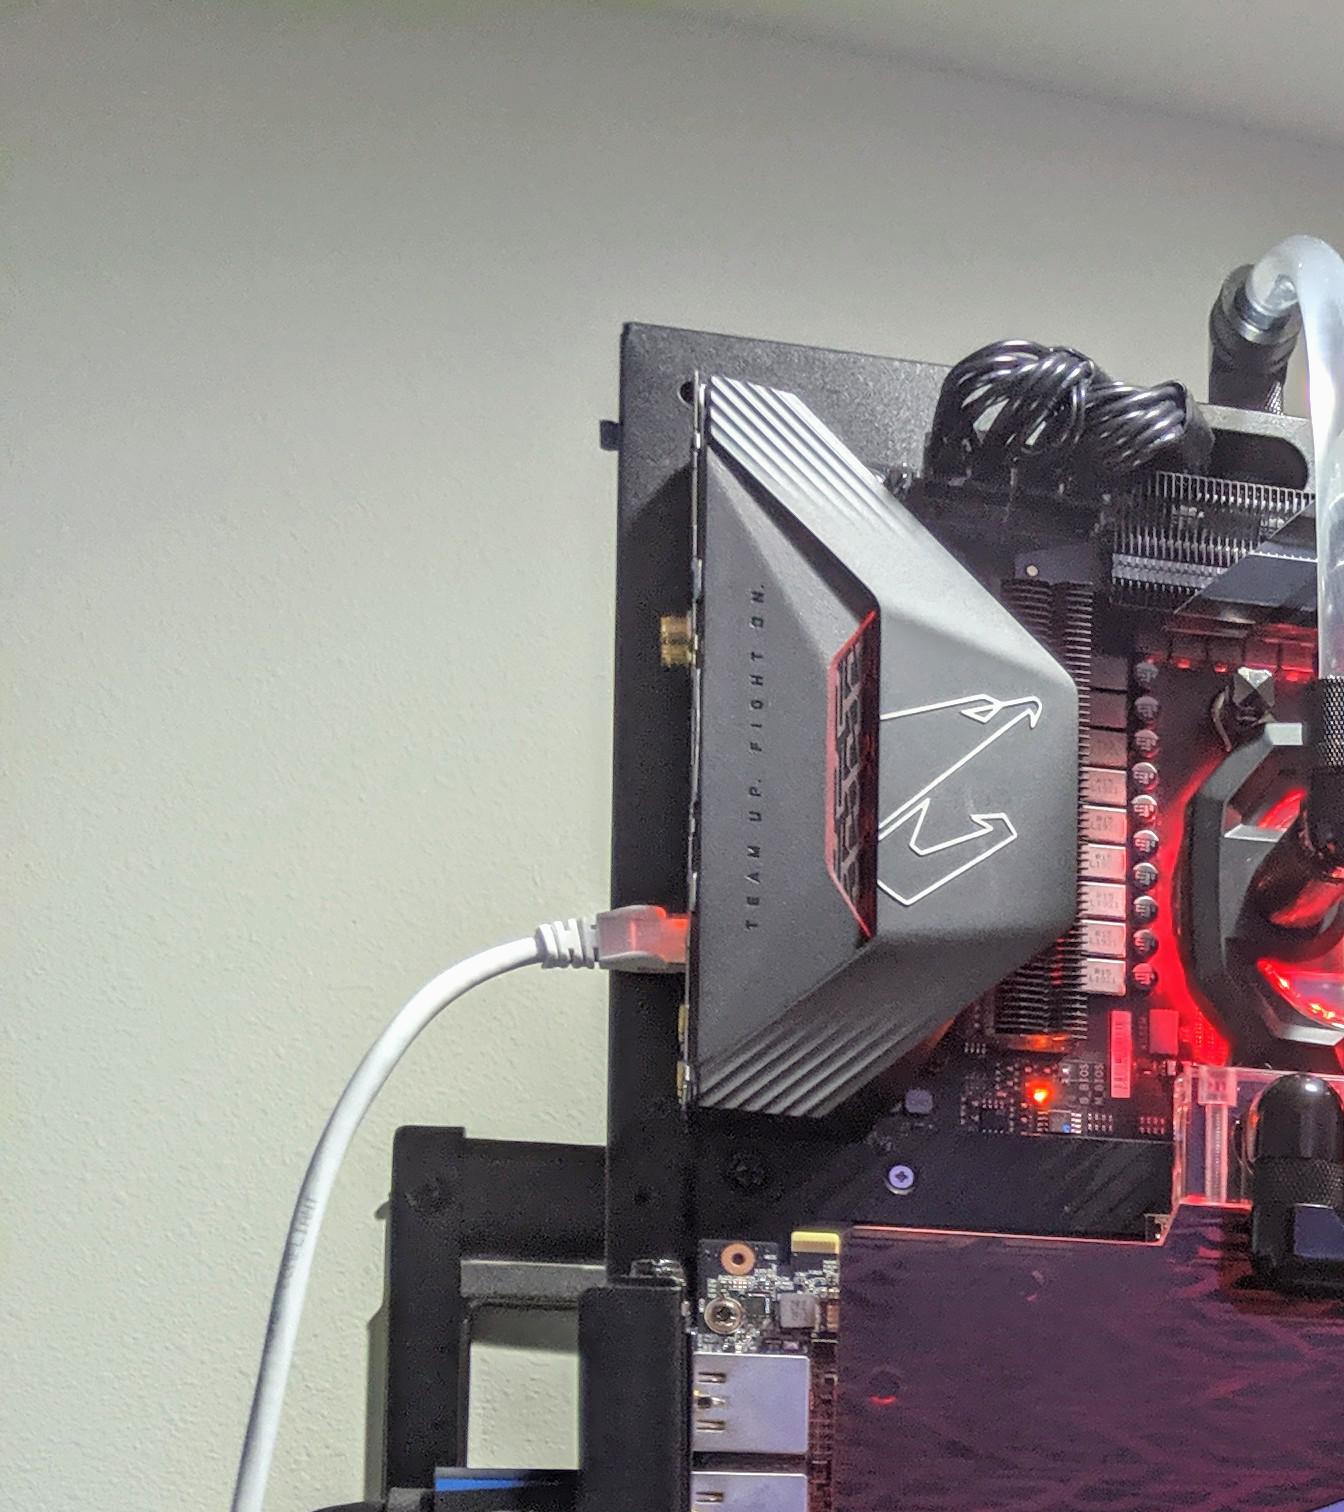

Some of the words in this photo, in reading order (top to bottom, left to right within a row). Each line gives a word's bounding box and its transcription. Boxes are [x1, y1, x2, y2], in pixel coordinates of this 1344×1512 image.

[750, 583, 766, 631] ON.
[749, 650, 765, 752] FIGHT
[750, 777, 763, 823] UP.
[744, 845, 761, 931] TEAM
